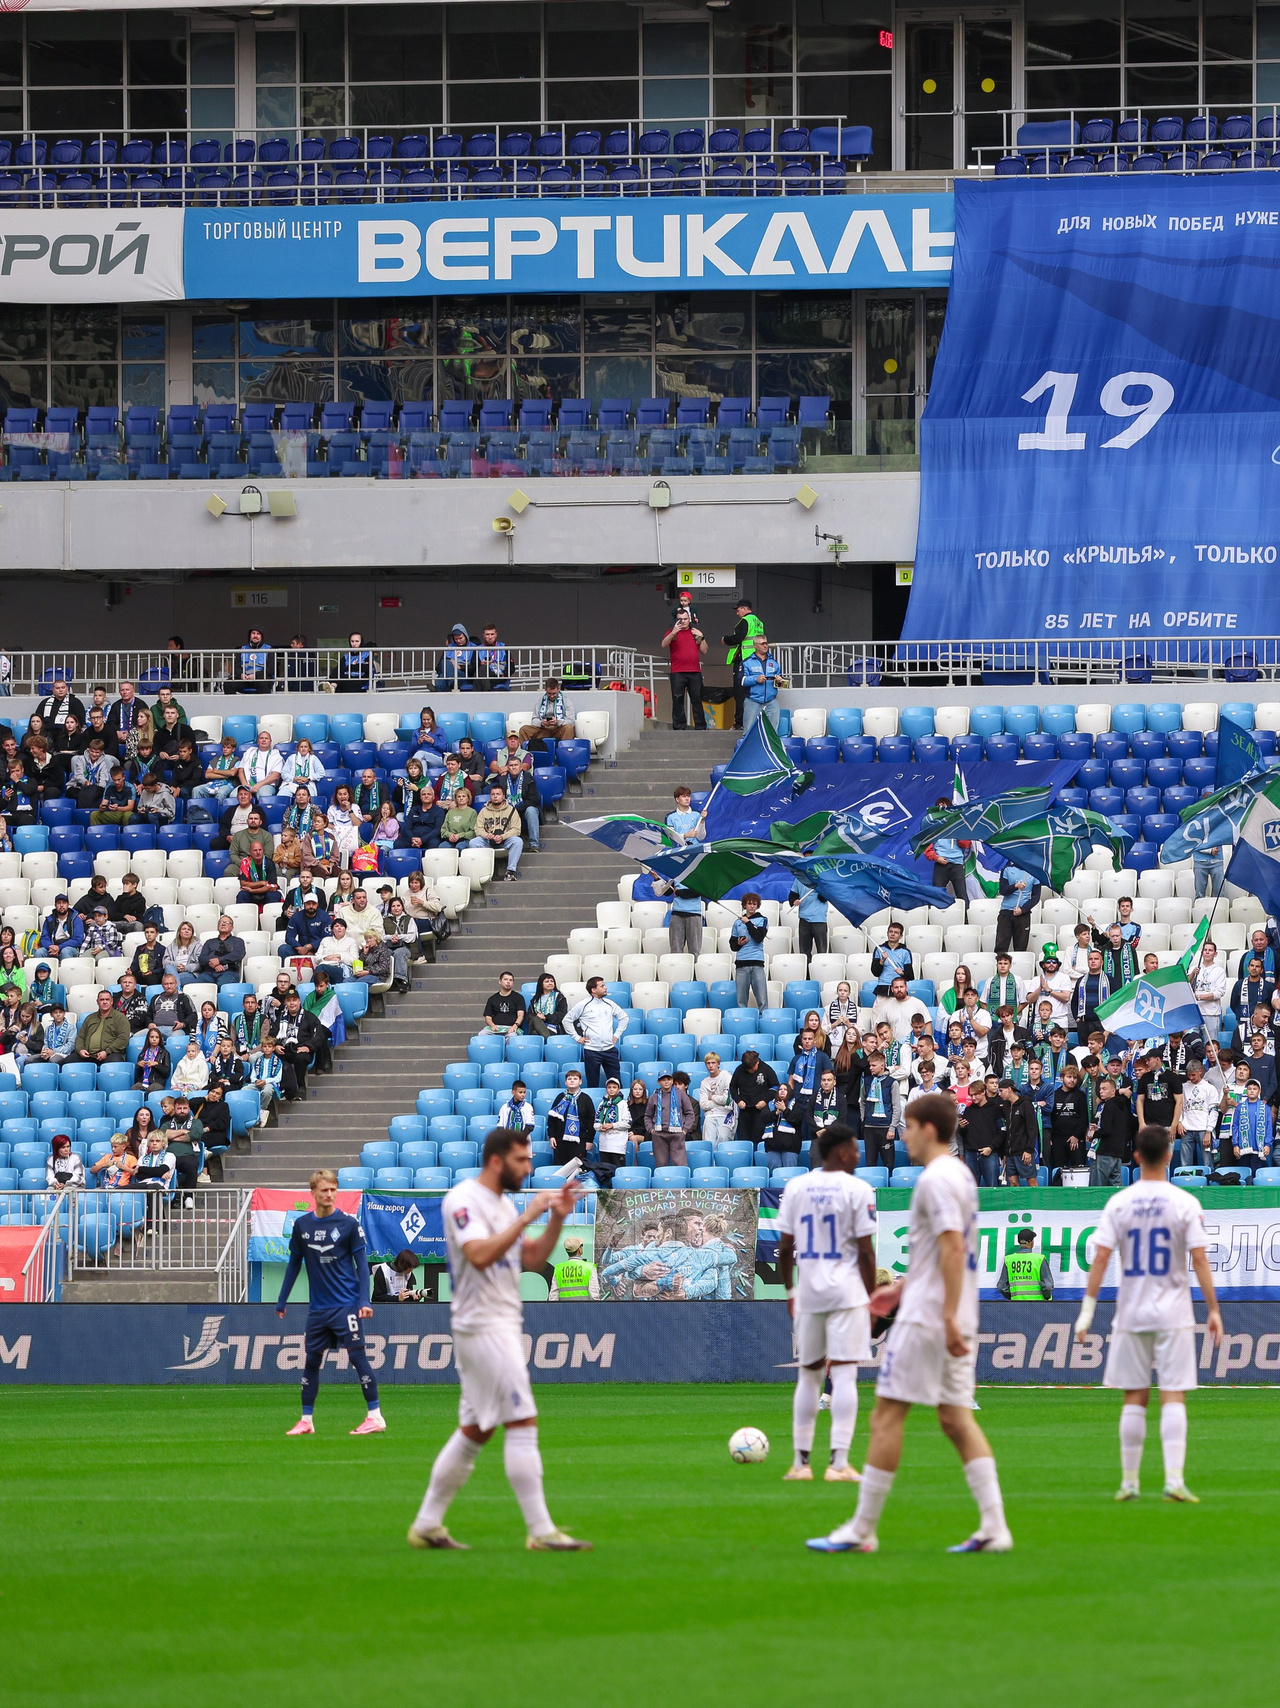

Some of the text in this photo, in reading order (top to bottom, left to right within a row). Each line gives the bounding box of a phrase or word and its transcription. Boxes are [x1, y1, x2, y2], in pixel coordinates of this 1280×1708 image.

[203, 218, 343, 241] ТОРГОВЫЙ ЦЕНТР
[1057, 215, 1091, 234] ДЛЯ
[1102, 213, 1158, 232] НОВЫХ
[1168, 215, 1225, 232] ПОБЕД
[0, 222, 151, 275] РОЙ
[1018, 370, 1176, 451] 19
[975, 549, 1050, 570] ТОЛЬКО
[1063, 545, 1177, 566] «КРЫЛЬЯ»,
[1194, 544, 1277, 565] ТОЛЬКО
[698, 572, 716, 584] 116
[251, 593, 269, 604] 116
[1044, 611, 1238, 630] 85 ЛЕТ НА ОРБИТЕ
[625, 1189, 741, 1207] ВПЕРЁД К ПОБЕДЕ
[628, 1201, 677, 1220] FORWARD
[680, 1200, 692, 1208] TO
[800, 1214, 843, 1260] 11
[1124, 1227, 1171, 1277] 16
[561, 1265, 584, 1278] 10213
[1011, 1260, 1033, 1274] 9873
[346, 1313, 359, 1332] 6
